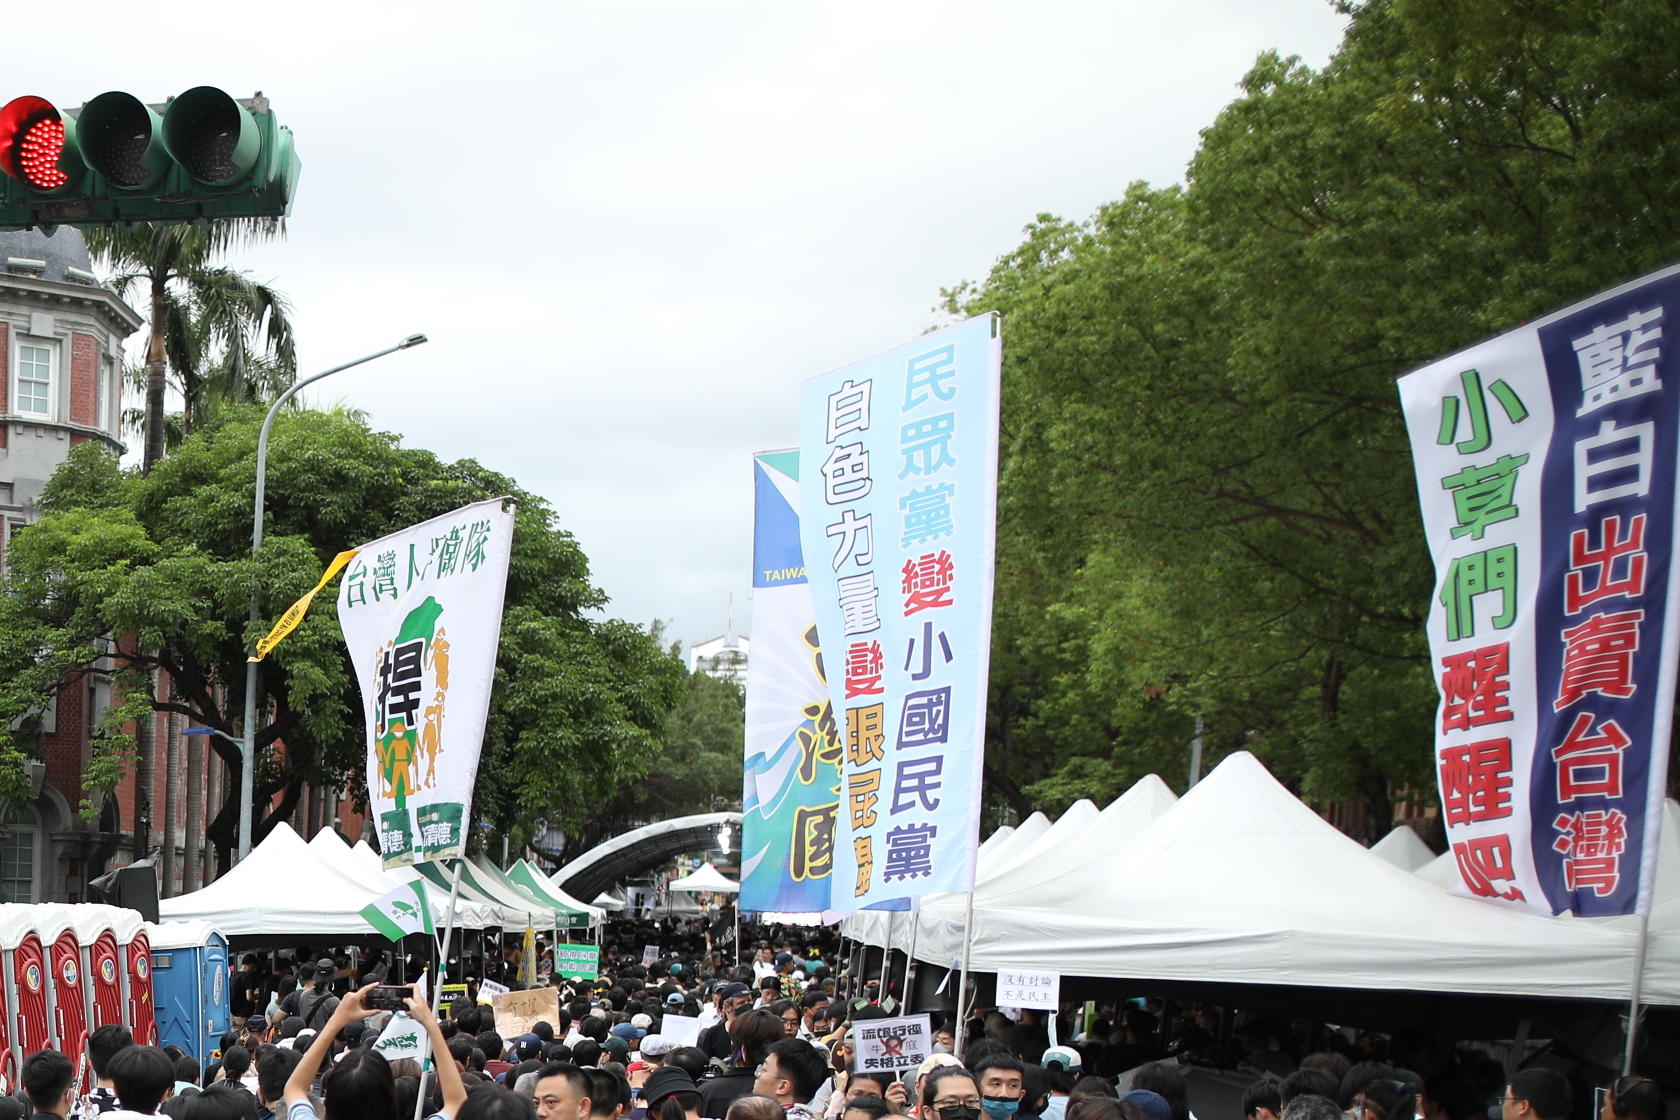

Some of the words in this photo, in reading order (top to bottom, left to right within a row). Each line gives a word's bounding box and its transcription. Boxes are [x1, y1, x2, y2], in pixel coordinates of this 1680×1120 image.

[347, 519, 491, 608] 台灣人衛隊
[764, 569, 808, 582] TAIWA
[1551, 306, 1665, 899] 藍白出賣台灣
[883, 343, 957, 885] 民眾黨變小國民黨
[377, 640, 425, 736] 捍
[1003, 974, 1052, 986] 沒有討論
[1003, 990, 1051, 1001] 不是民主
[861, 1023, 923, 1040] 流氓行徑
[870, 1043, 883, 1054] 牛
[905, 1040, 918, 1051] 庭
[864, 1053, 925, 1069] 失格立委
